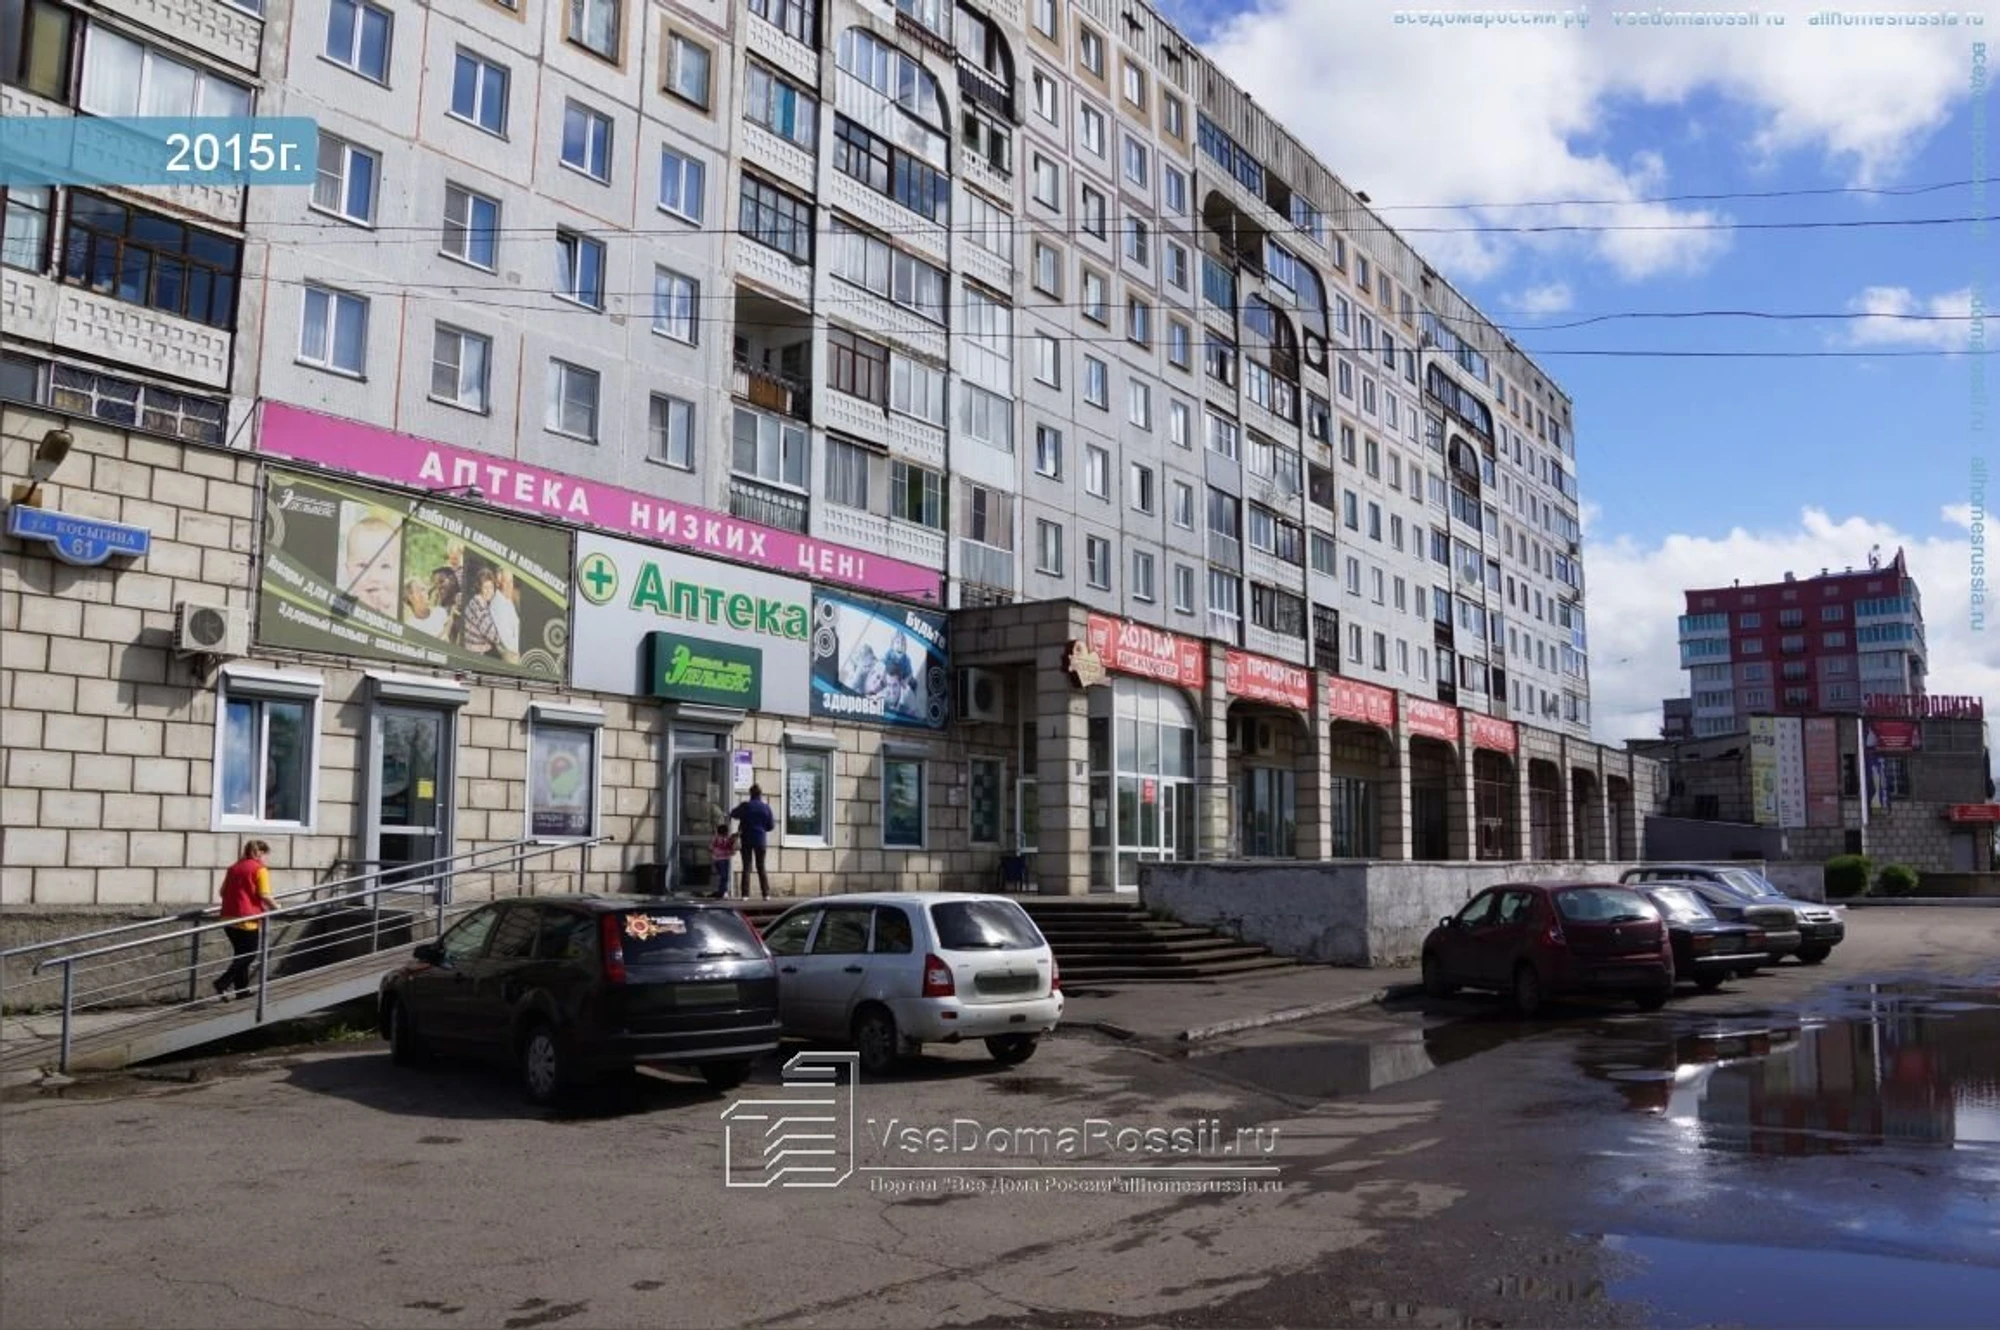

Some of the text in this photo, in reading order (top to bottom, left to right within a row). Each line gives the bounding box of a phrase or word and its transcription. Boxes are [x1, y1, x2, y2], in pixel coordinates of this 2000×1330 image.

[56, 521, 136, 546] КОСЫГИНА
[418, 451, 866, 580] АПТЕКА НИЗКИХ ЦЕН!
[71, 538, 94, 558] 61
[629, 559, 810, 642] Аптека
